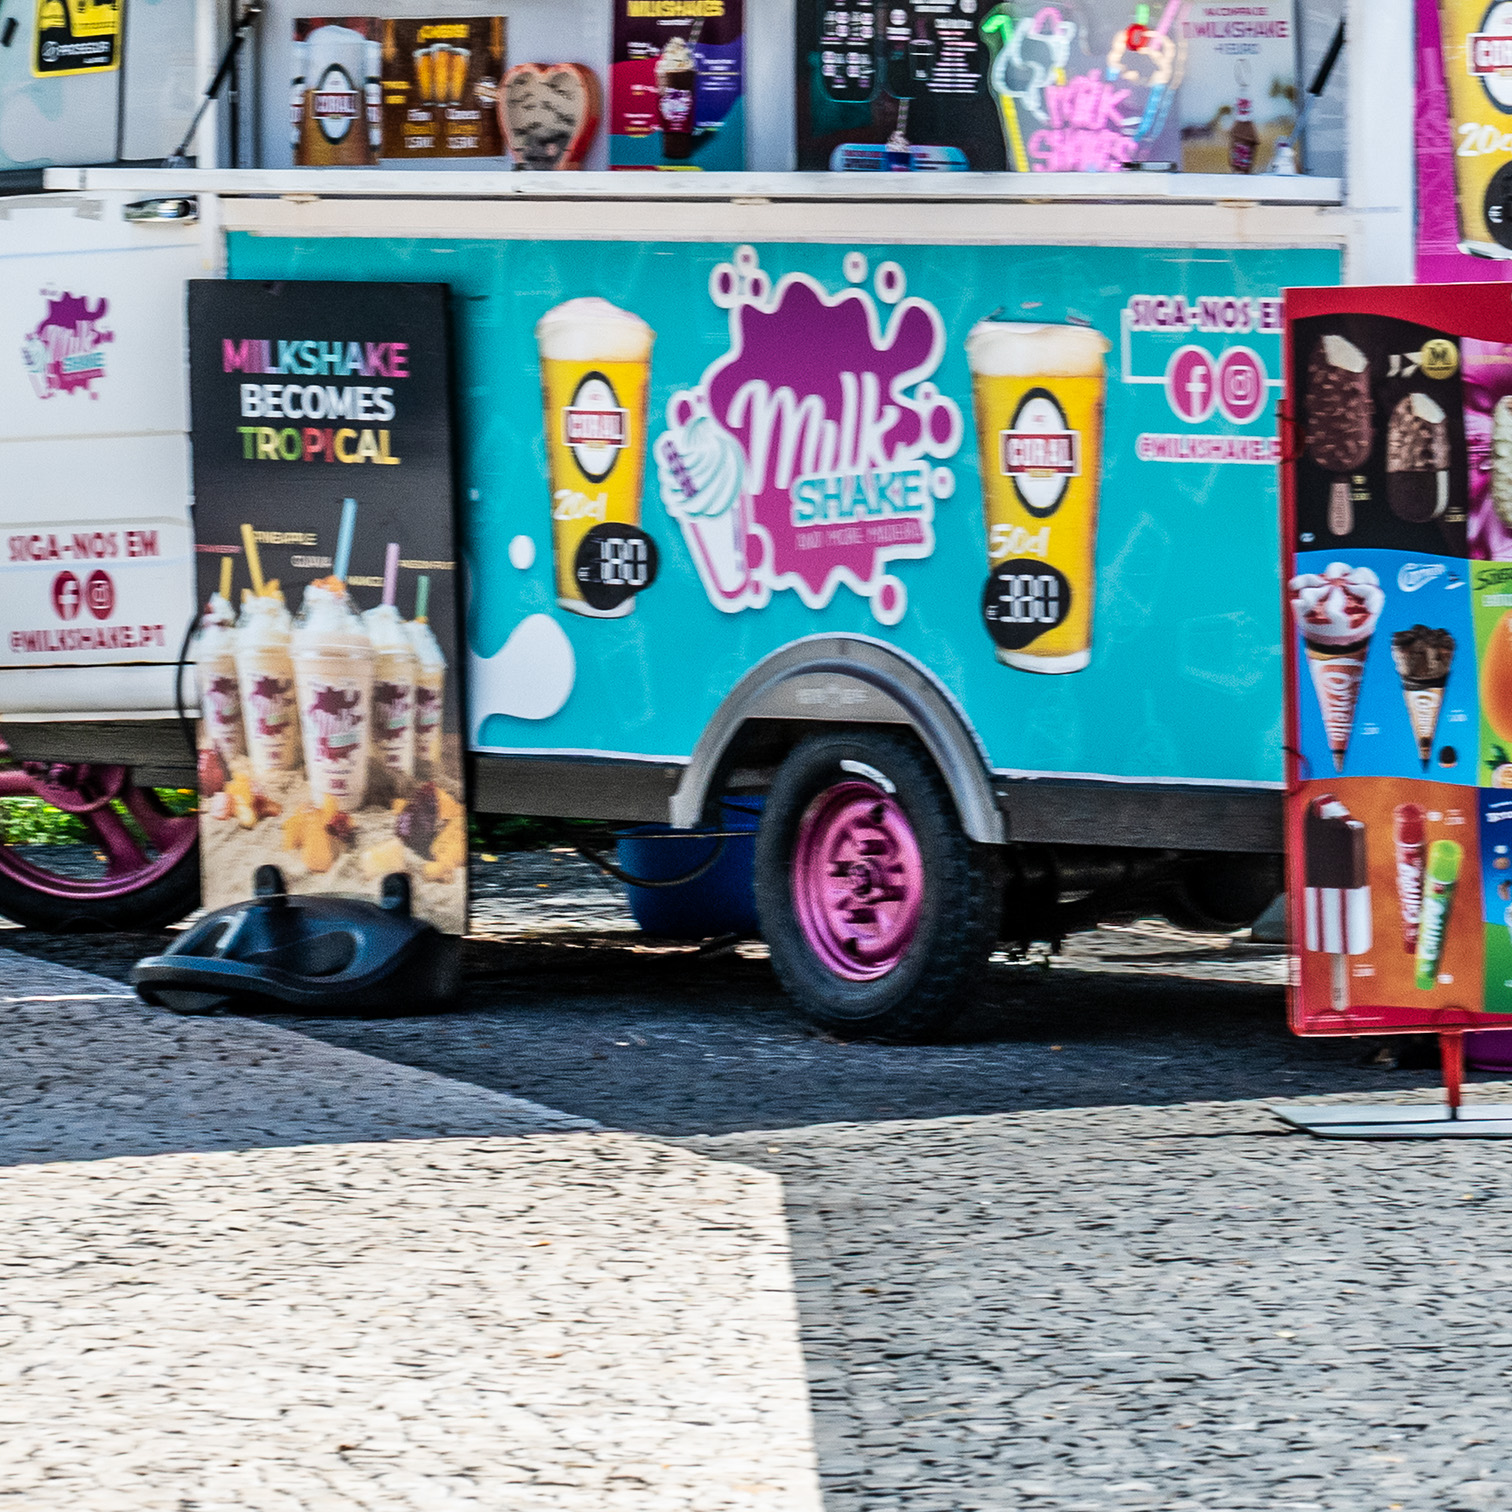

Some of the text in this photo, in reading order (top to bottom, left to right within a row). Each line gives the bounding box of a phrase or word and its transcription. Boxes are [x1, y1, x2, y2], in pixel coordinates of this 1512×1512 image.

[1132, 299, 1252, 329] SIGA-NOS
[222, 338, 411, 379] MILKSHAKE
[240, 383, 397, 422] BECOMES
[236, 425, 402, 466] TROPICAL
[725, 370, 902, 496] Milk
[1006, 438, 1074, 467] CORAL
[794, 469, 925, 521] SHAKE
[7, 529, 161, 562] SIGA-NOS EM
